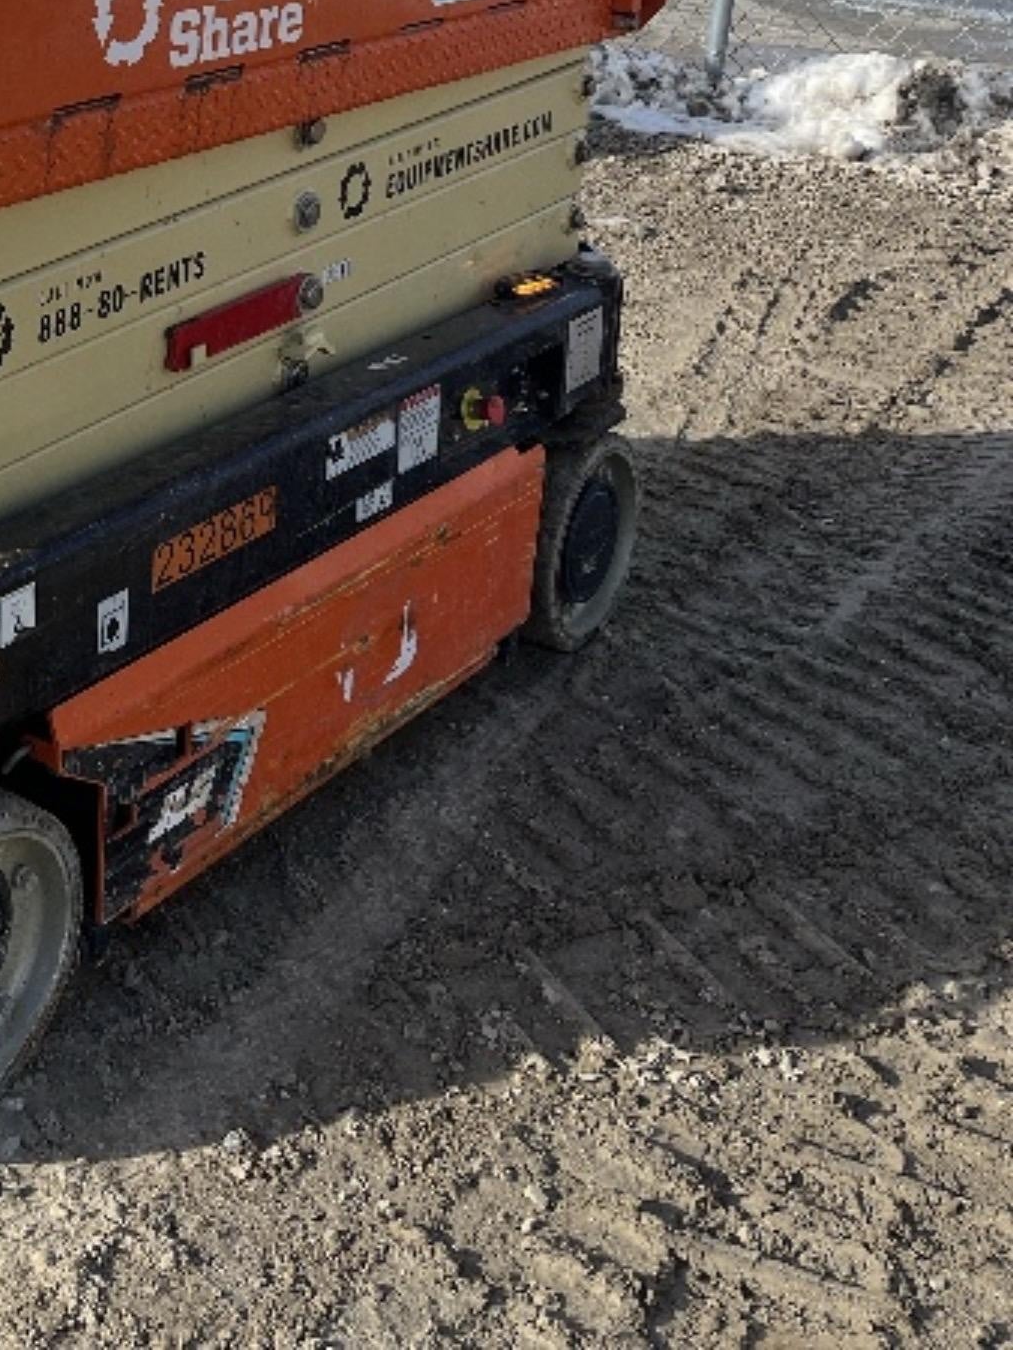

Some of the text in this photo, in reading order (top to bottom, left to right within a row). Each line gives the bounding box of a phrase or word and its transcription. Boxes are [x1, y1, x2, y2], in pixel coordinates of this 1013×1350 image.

[168, 1, 304, 69] Share
[38, 251, 205, 343] 888-80-RENTS
[155, 488, 275, 588] 232869
